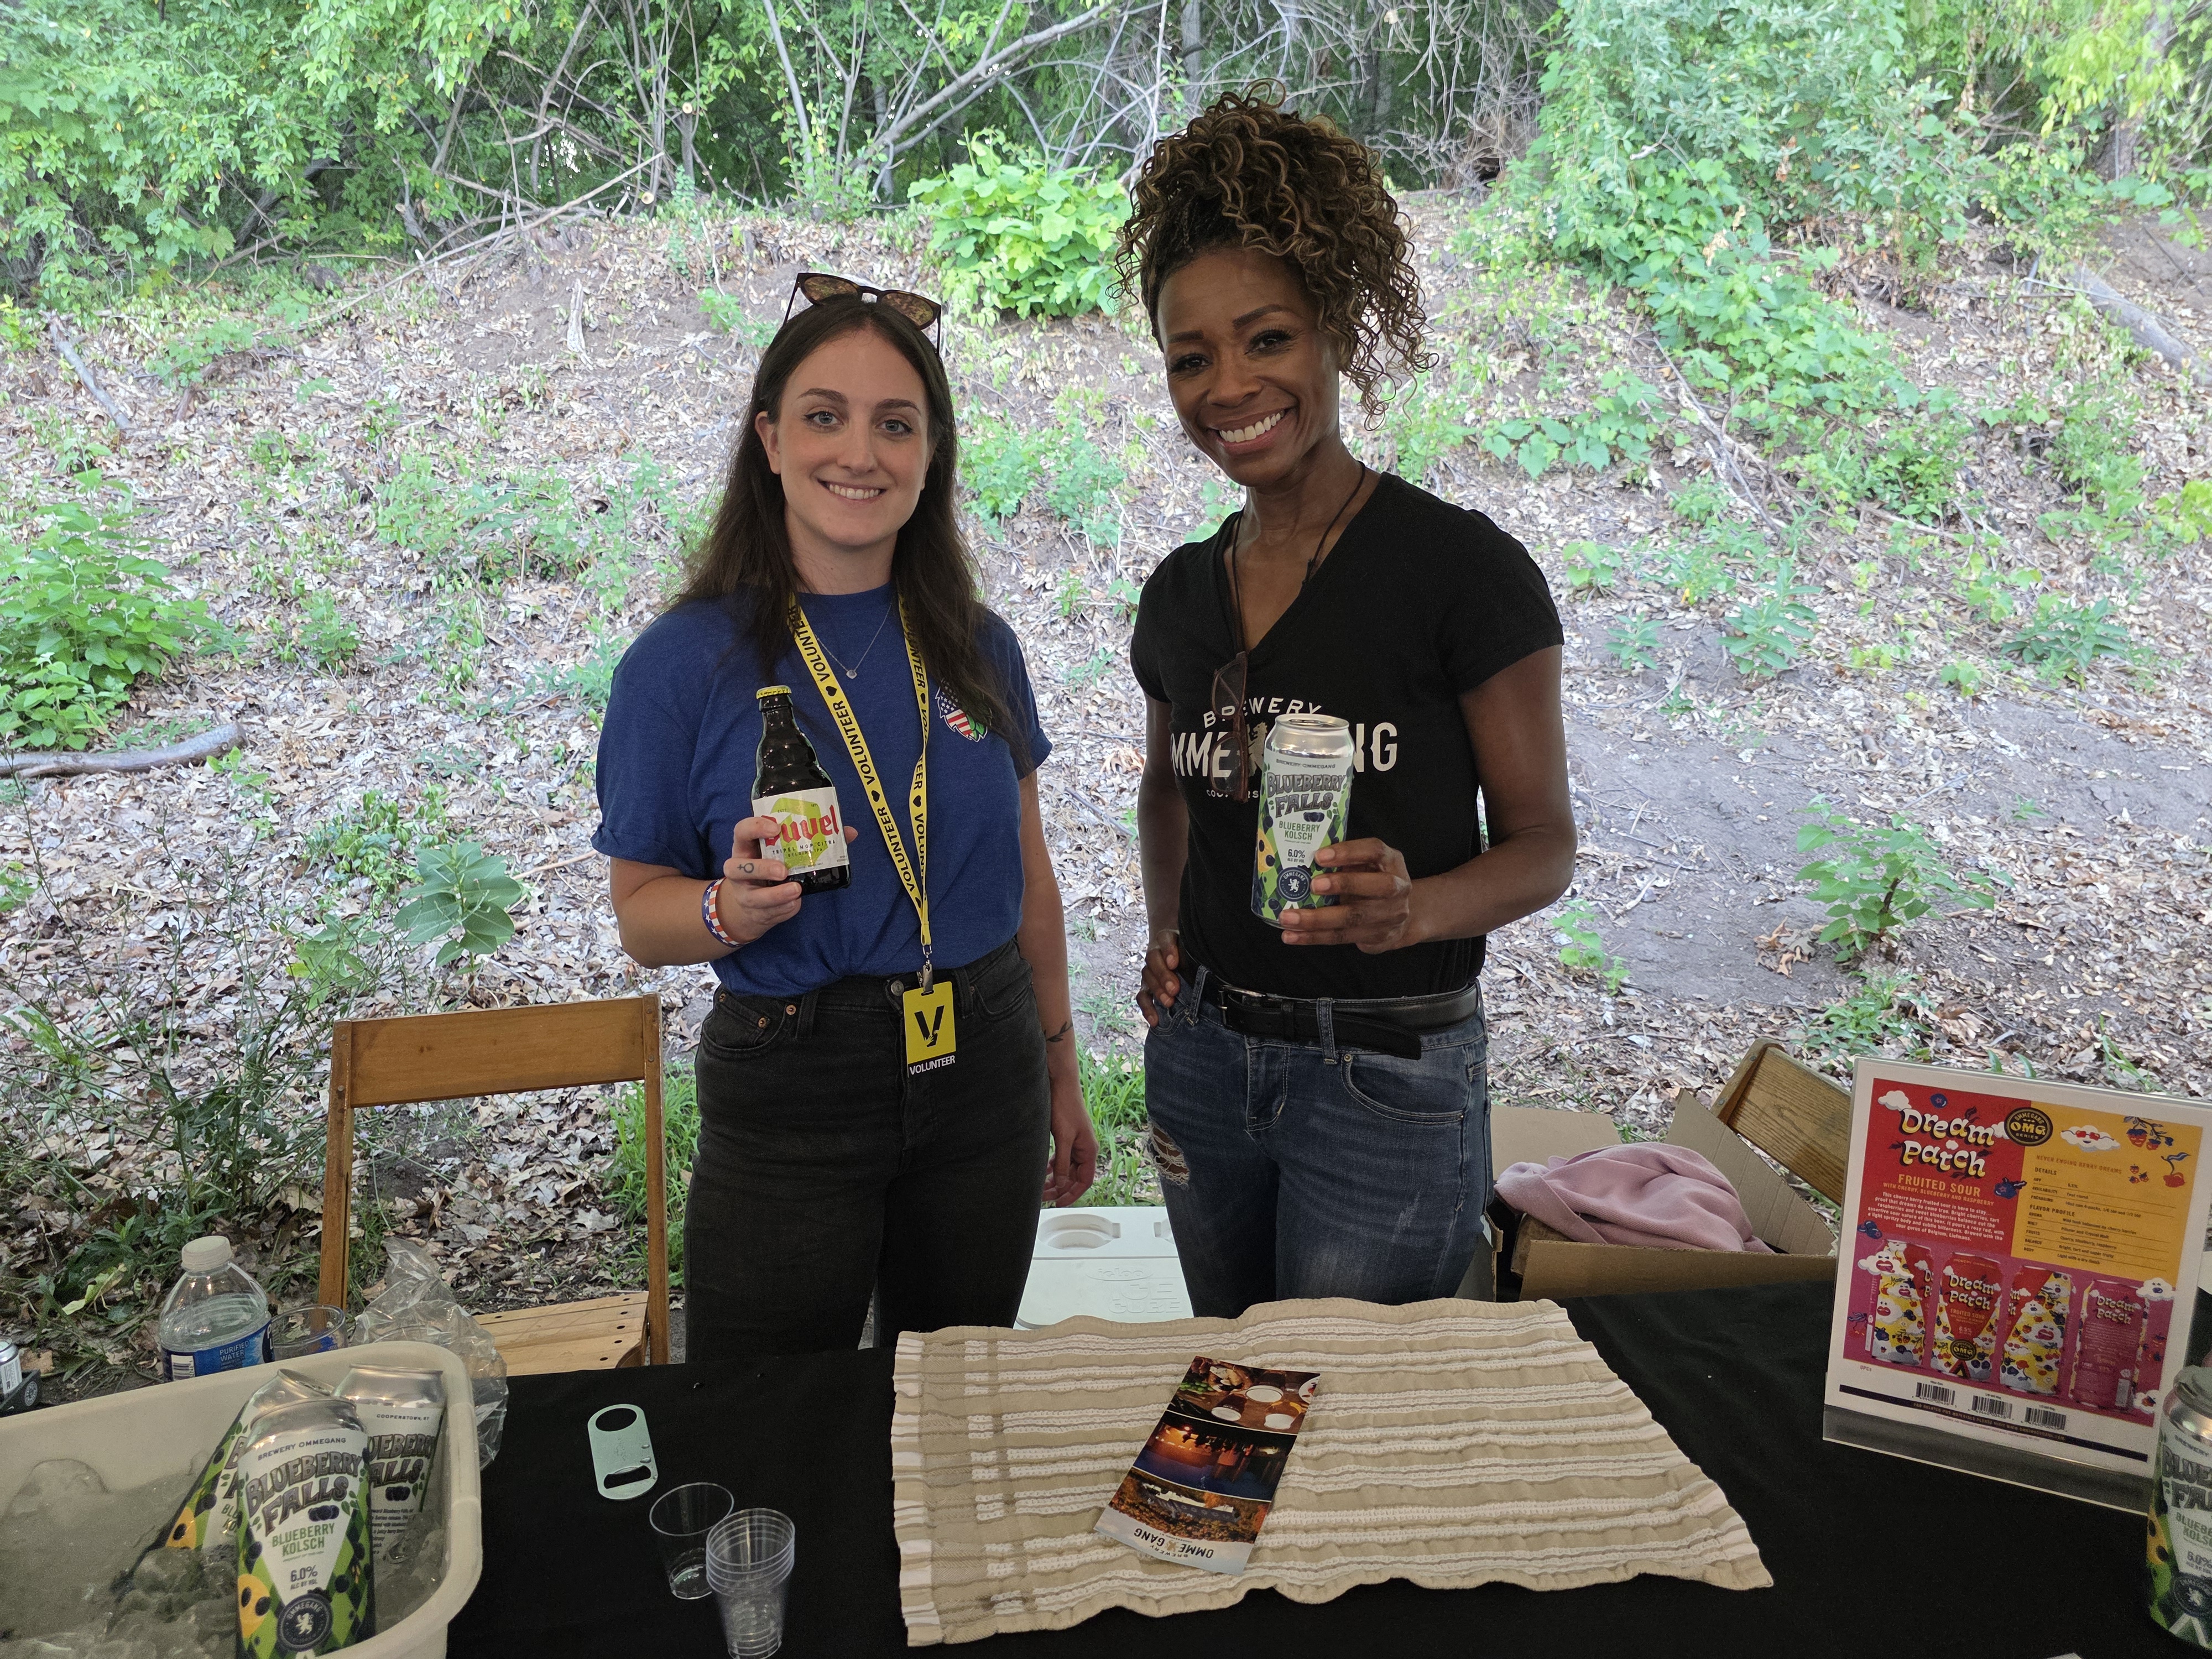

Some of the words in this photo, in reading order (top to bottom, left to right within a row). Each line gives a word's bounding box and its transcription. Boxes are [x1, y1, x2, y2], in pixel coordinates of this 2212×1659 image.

[833, 700, 875, 785] VOLUNTEER
[1276, 758, 1301, 767] BREWERY
[1267, 773, 1347, 798] BLUEBERRY
[1275, 792, 1334, 818] FALLS
[1279, 820, 1321, 833] BLUEBERRY
[1285, 830, 1313, 841] KOLSCH
[773, 846, 796, 855] TRIPEL
[877, 806, 915, 892] VOLUNTEER
[1288, 849, 1306, 858] 6.0%
[1282, 872, 1306, 881] OMMEGANG
[909, 1055, 956, 1075] VOLUNTEER
[2014, 1110, 2045, 1124] OMMEGANG
[1901, 1108, 1995, 1146] Dream
[2010, 1121, 2046, 1135] OMG
[1902, 1140, 1985, 1177] Patch
[2034, 1167, 2057, 1175] DETAILS
[2099, 1165, 2122, 1174] DREAMS
[1898, 1174, 1946, 1191] FRUITED
[1950, 1182, 1981, 1197] SOUR
[1897, 1184, 1918, 1193] CHERRY,
[1920, 1188, 1950, 1198] BLUEBERRY
[1963, 1196, 1994, 1206] RASPBERRY
[1877, 1203, 1903, 1211] raspberries
[1929, 1212, 1956, 1220] blueberries
[2029, 1204, 2049, 1212] FLAVOR
[2051, 1208, 2075, 1217] PROFILE
[1937, 1224, 1963, 1233] bitterness.
[1948, 1233, 1971, 1241] Liefmans.
[1949, 1274, 1994, 1295] Dream
[1949, 1290, 1991, 1311] Patch
[2096, 1296, 2135, 1312] Dream
[2096, 1308, 2132, 1325] Patch
[220, 1340, 249, 1355] PURIFIED
[220, 1349, 244, 1361] WATER
[1953, 1346, 1974, 1356] OMG
[257, 1443, 296, 1461] BREWERY
[299, 1437, 347, 1448] OMMEGANG
[369, 1459, 424, 1488] ALLS
[246, 1451, 363, 1518] BLUEBERRY
[262, 1475, 349, 1537] FALLS
[272, 1522, 336, 1548] BLUEBERRY
[1134, 1528, 1165, 1547] GANG
[282, 1536, 325, 1557] KOLSCH
[1150, 1545, 1188, 1558] BREWERY
[1178, 1543, 1214, 1558] OMME
[290, 1564, 319, 1583] 6.0%
[286, 1601, 323, 1619] OMMEGANG
